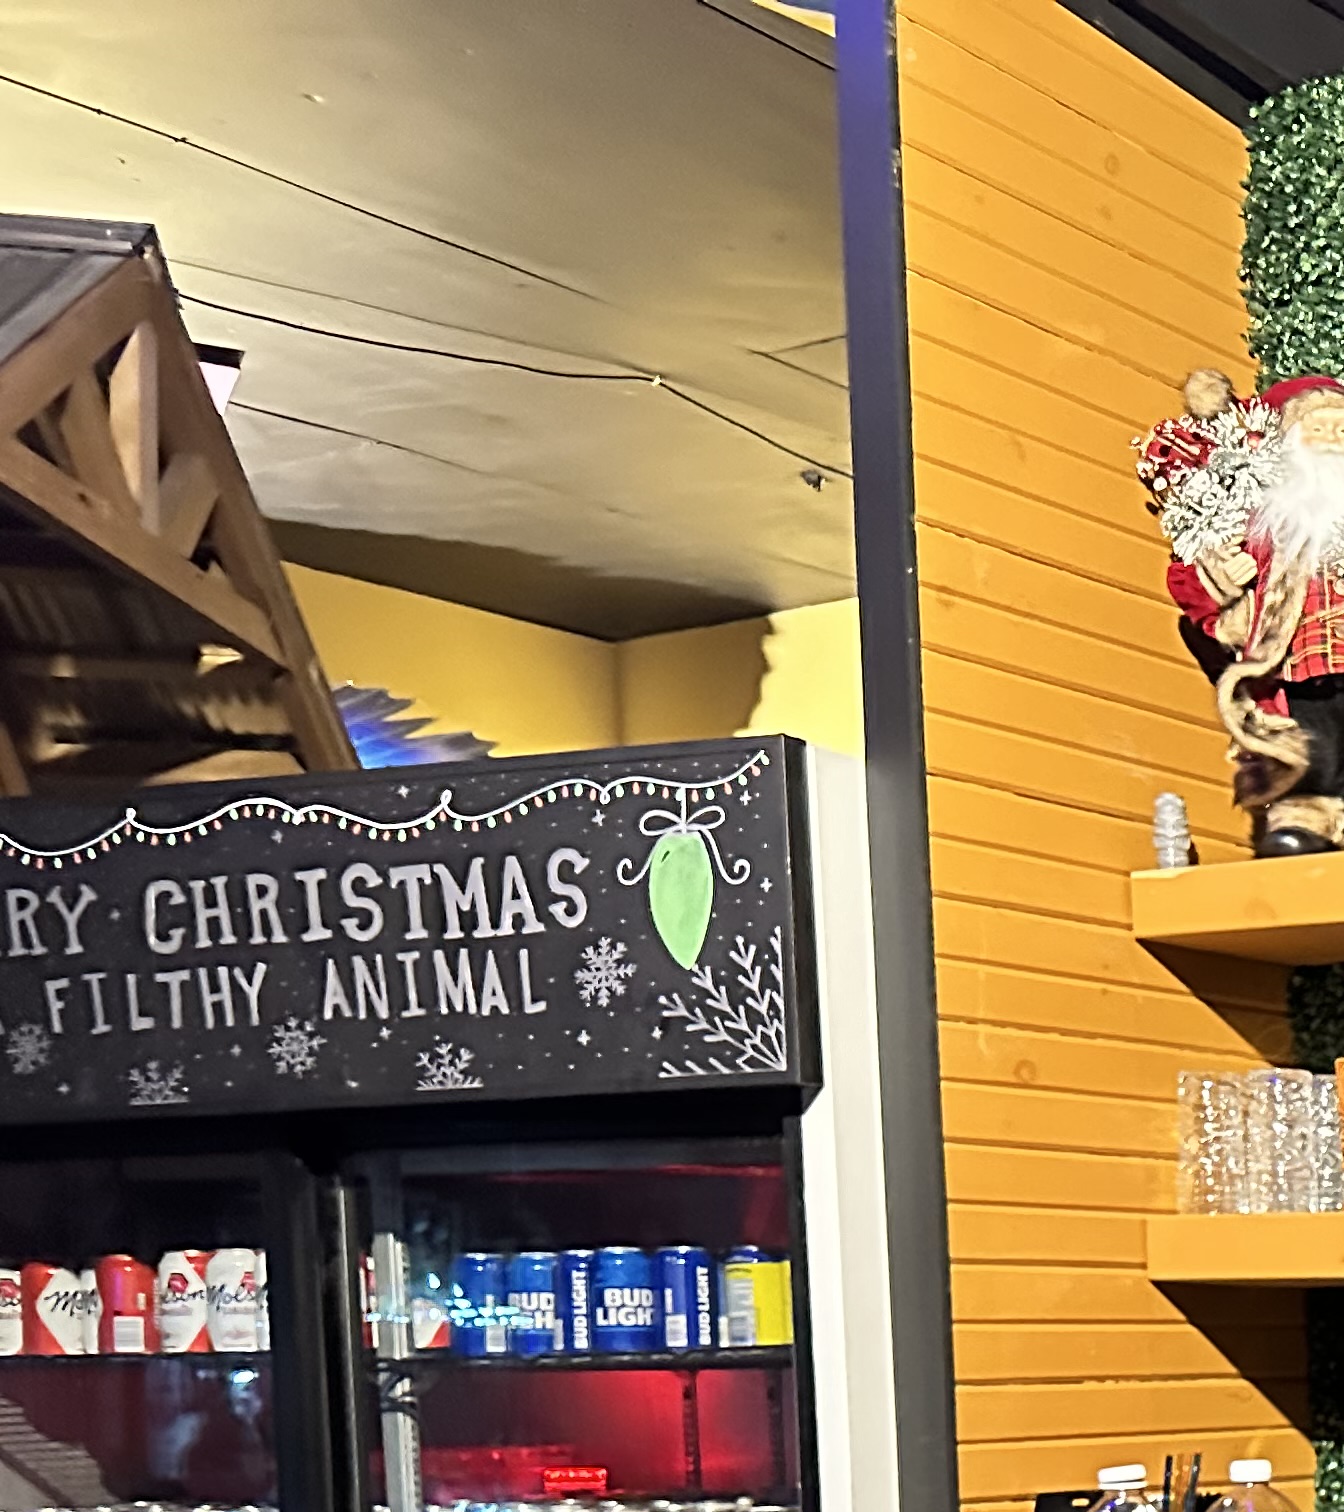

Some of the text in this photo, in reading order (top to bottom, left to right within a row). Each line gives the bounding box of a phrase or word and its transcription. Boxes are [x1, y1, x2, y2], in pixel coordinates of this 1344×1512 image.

[145, 846, 590, 955] CHRISTMAS
[45, 947, 548, 1034] FILTHY ANIMAL
[603, 1287, 653, 1308] BUD
